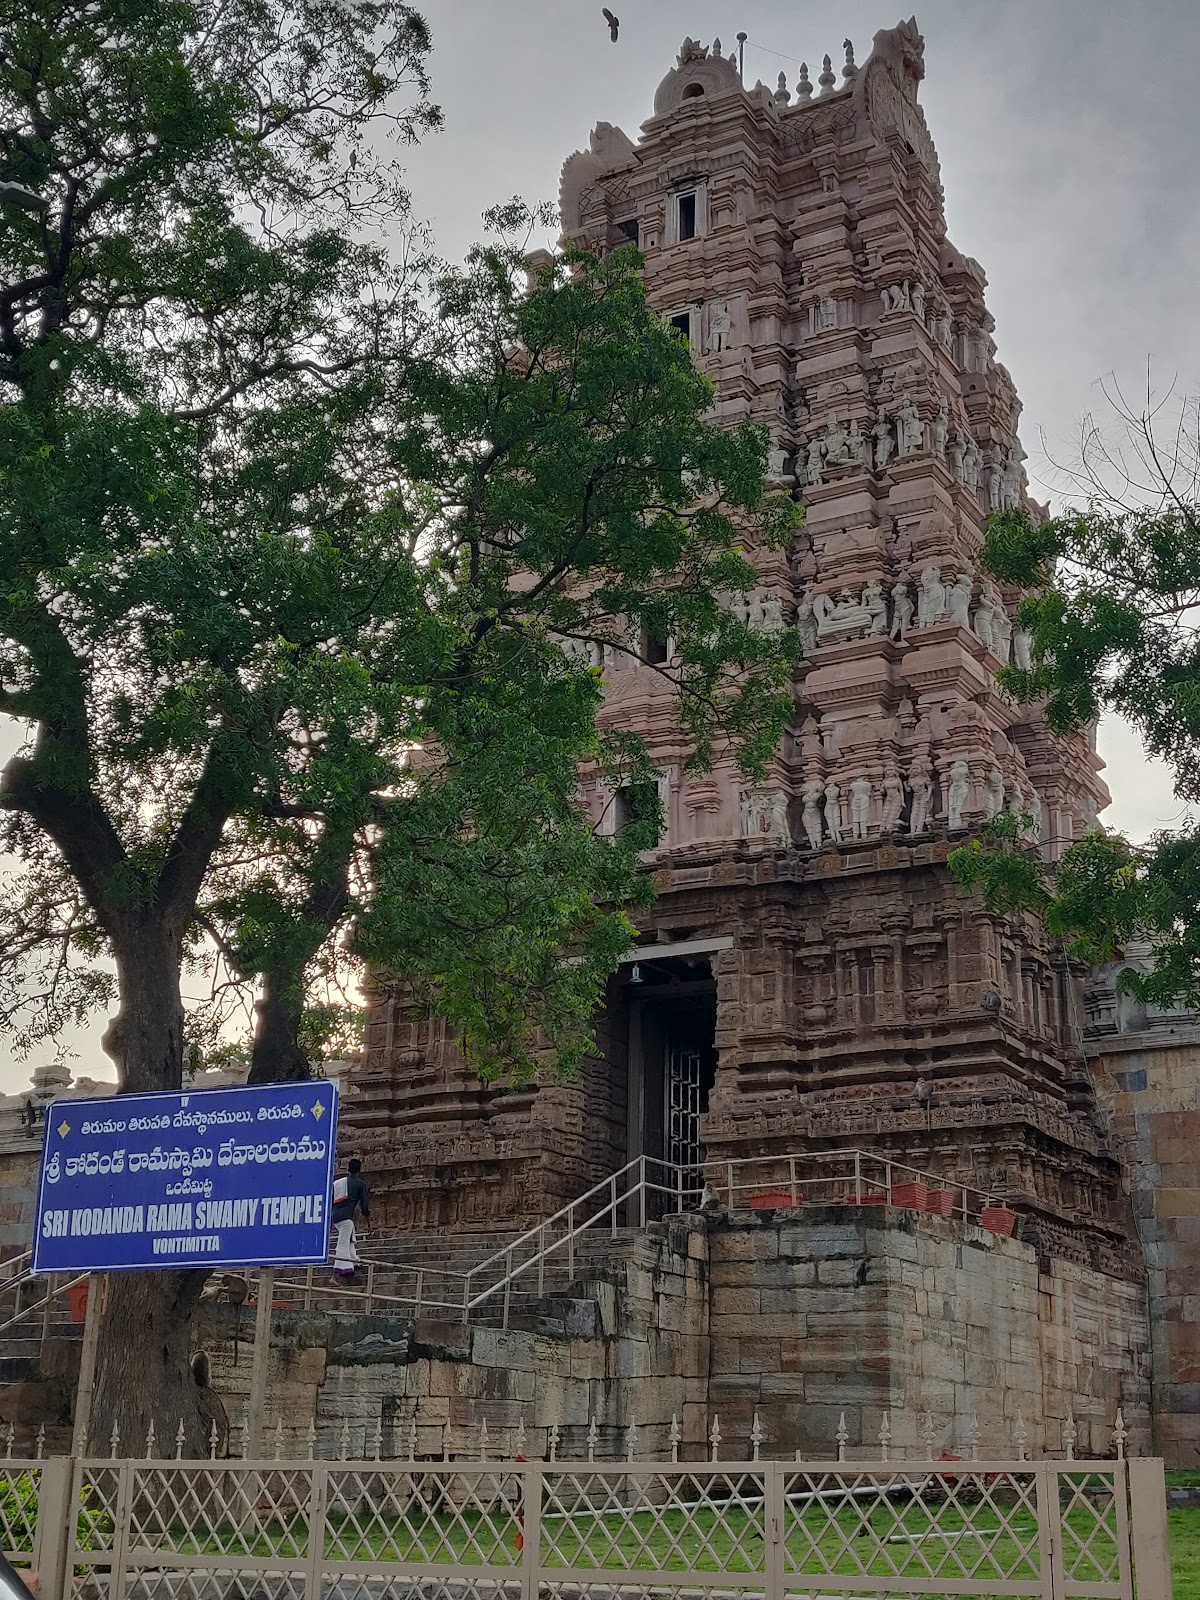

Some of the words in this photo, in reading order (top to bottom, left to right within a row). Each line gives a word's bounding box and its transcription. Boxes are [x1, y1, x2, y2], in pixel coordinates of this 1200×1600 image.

[81, 1119, 126, 1134] తిరుమల
[128, 1114, 170, 1131] తిరుపతి
[173, 1109, 254, 1134] దేవస్థానములు,
[257, 1104, 304, 1121] తిరుపతి.
[45, 1151, 61, 1184] శ్రీ
[65, 1148, 126, 1176] కోదండ
[128, 1145, 213, 1176] రామస్వామి
[218, 1135, 325, 1165] దేవాలయము
[43, 1208, 68, 1238] SRI
[71, 1205, 143, 1236] KODANDA
[146, 1202, 192, 1232] RAMA
[196, 1198, 260, 1229] SWAMY
[261, 1195, 322, 1226] TEMPLE
[153, 1236, 220, 1254] VONTIMITTA
